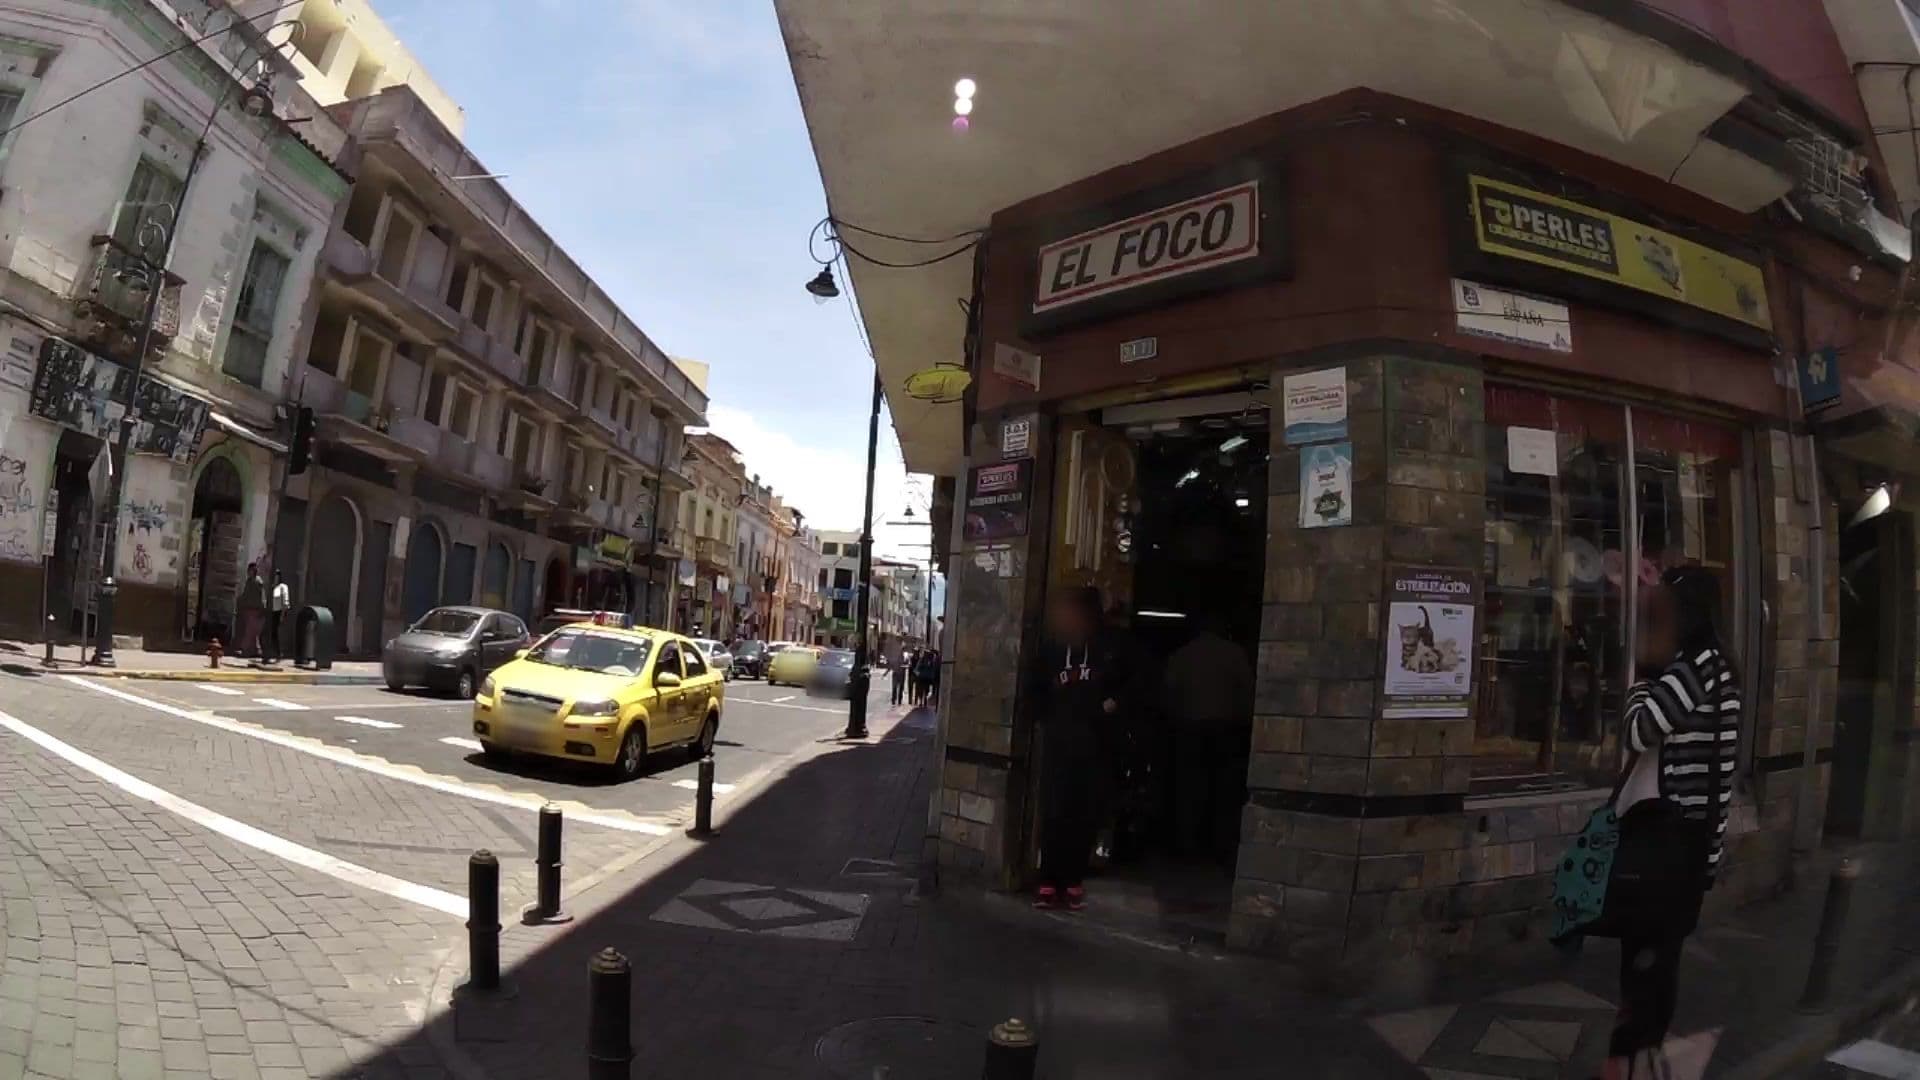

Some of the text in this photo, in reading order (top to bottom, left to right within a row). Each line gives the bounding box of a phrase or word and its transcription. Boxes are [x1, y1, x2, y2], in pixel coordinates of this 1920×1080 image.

[1050, 202, 1235, 293] EL FOCO
[1512, 203, 1611, 253] PERLES
